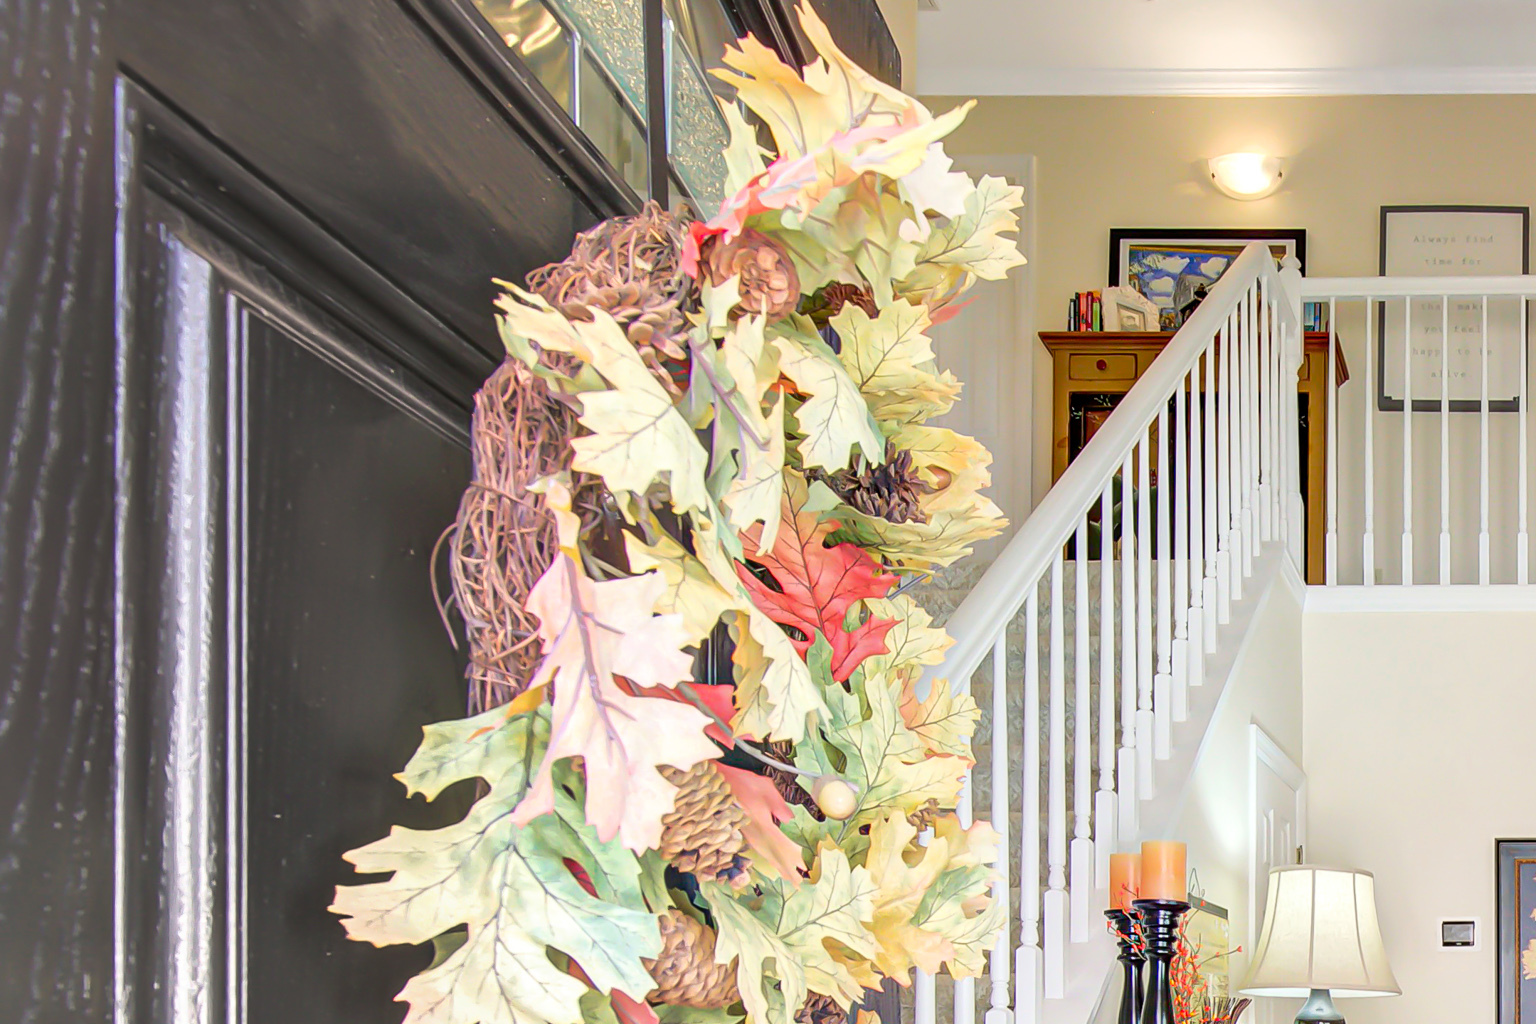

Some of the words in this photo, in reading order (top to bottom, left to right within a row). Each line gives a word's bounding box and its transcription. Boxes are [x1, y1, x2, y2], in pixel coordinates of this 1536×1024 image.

[1413, 234, 1456, 244] Always
[1424, 257, 1453, 265] time
[1462, 257, 1482, 265] for
[1421, 302, 1443, 311] tha
[1412, 347, 1442, 357] happ
